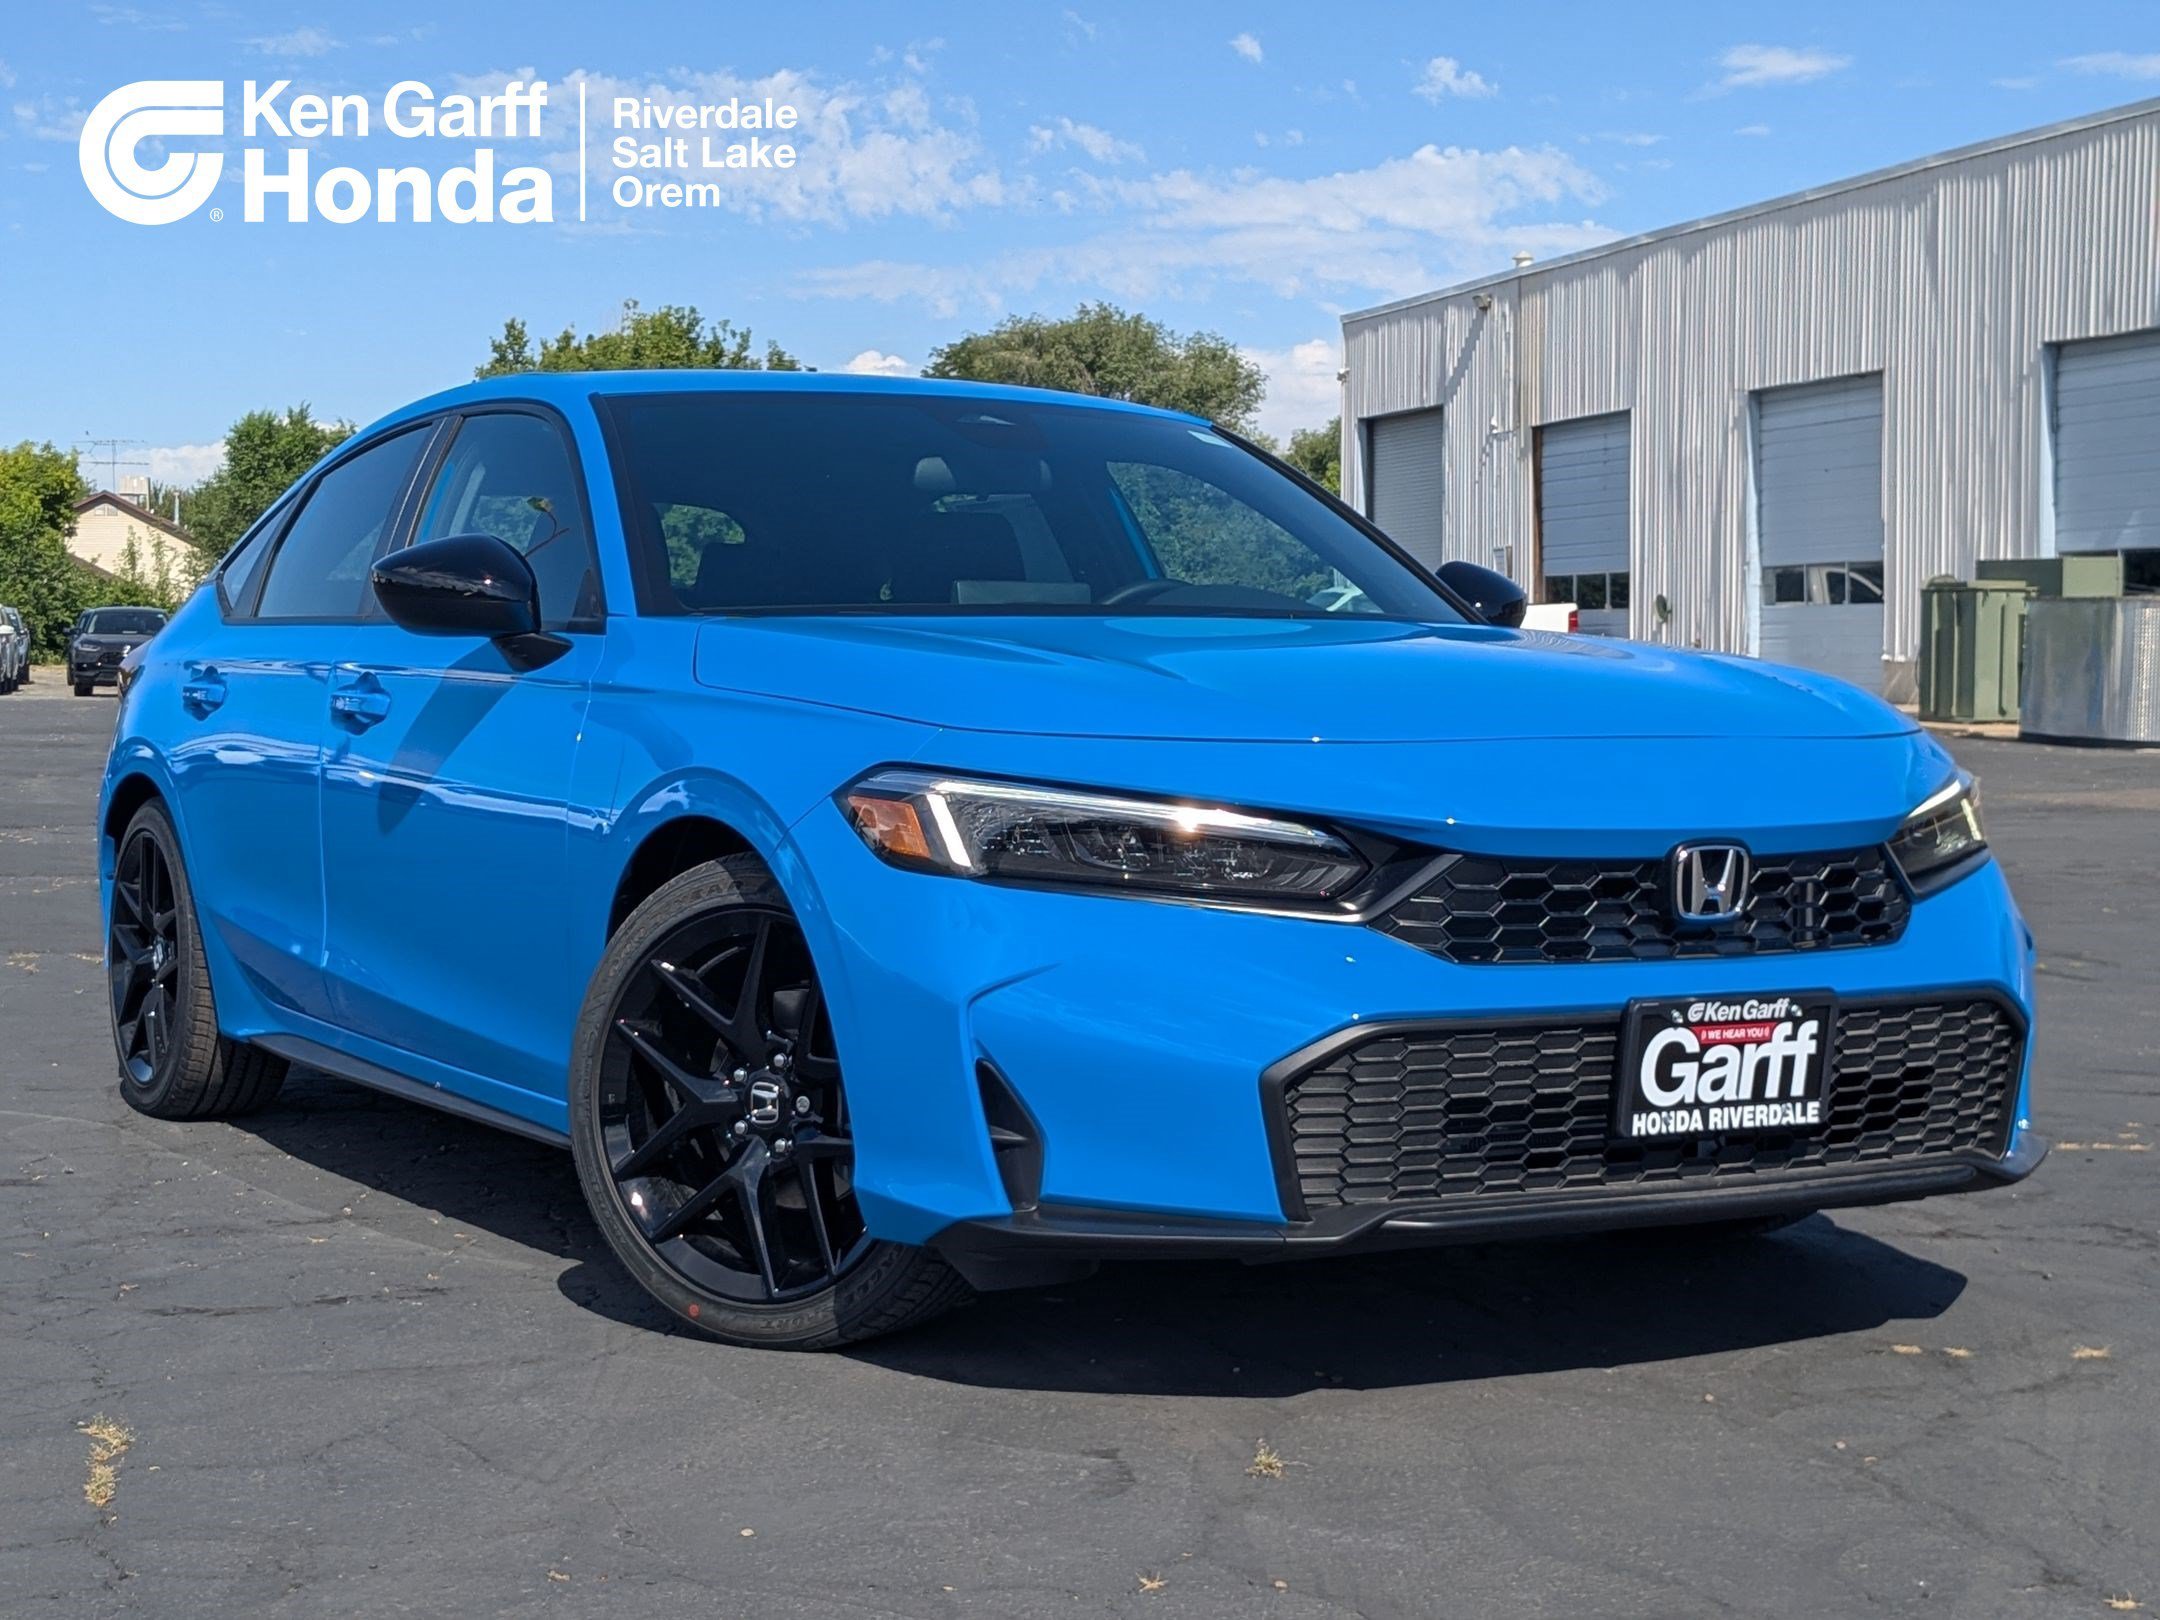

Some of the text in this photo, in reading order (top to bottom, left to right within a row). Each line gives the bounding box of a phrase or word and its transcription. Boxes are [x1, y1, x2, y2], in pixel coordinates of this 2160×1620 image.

[1704, 1001, 1741, 1022] Ken
[1742, 997, 1790, 1020] Garff
[1708, 1026, 1764, 1040] WE HEAR YOU
[1640, 1020, 1818, 1107] Garff
[1631, 1101, 1821, 1137] HONDA RIVERDALE
